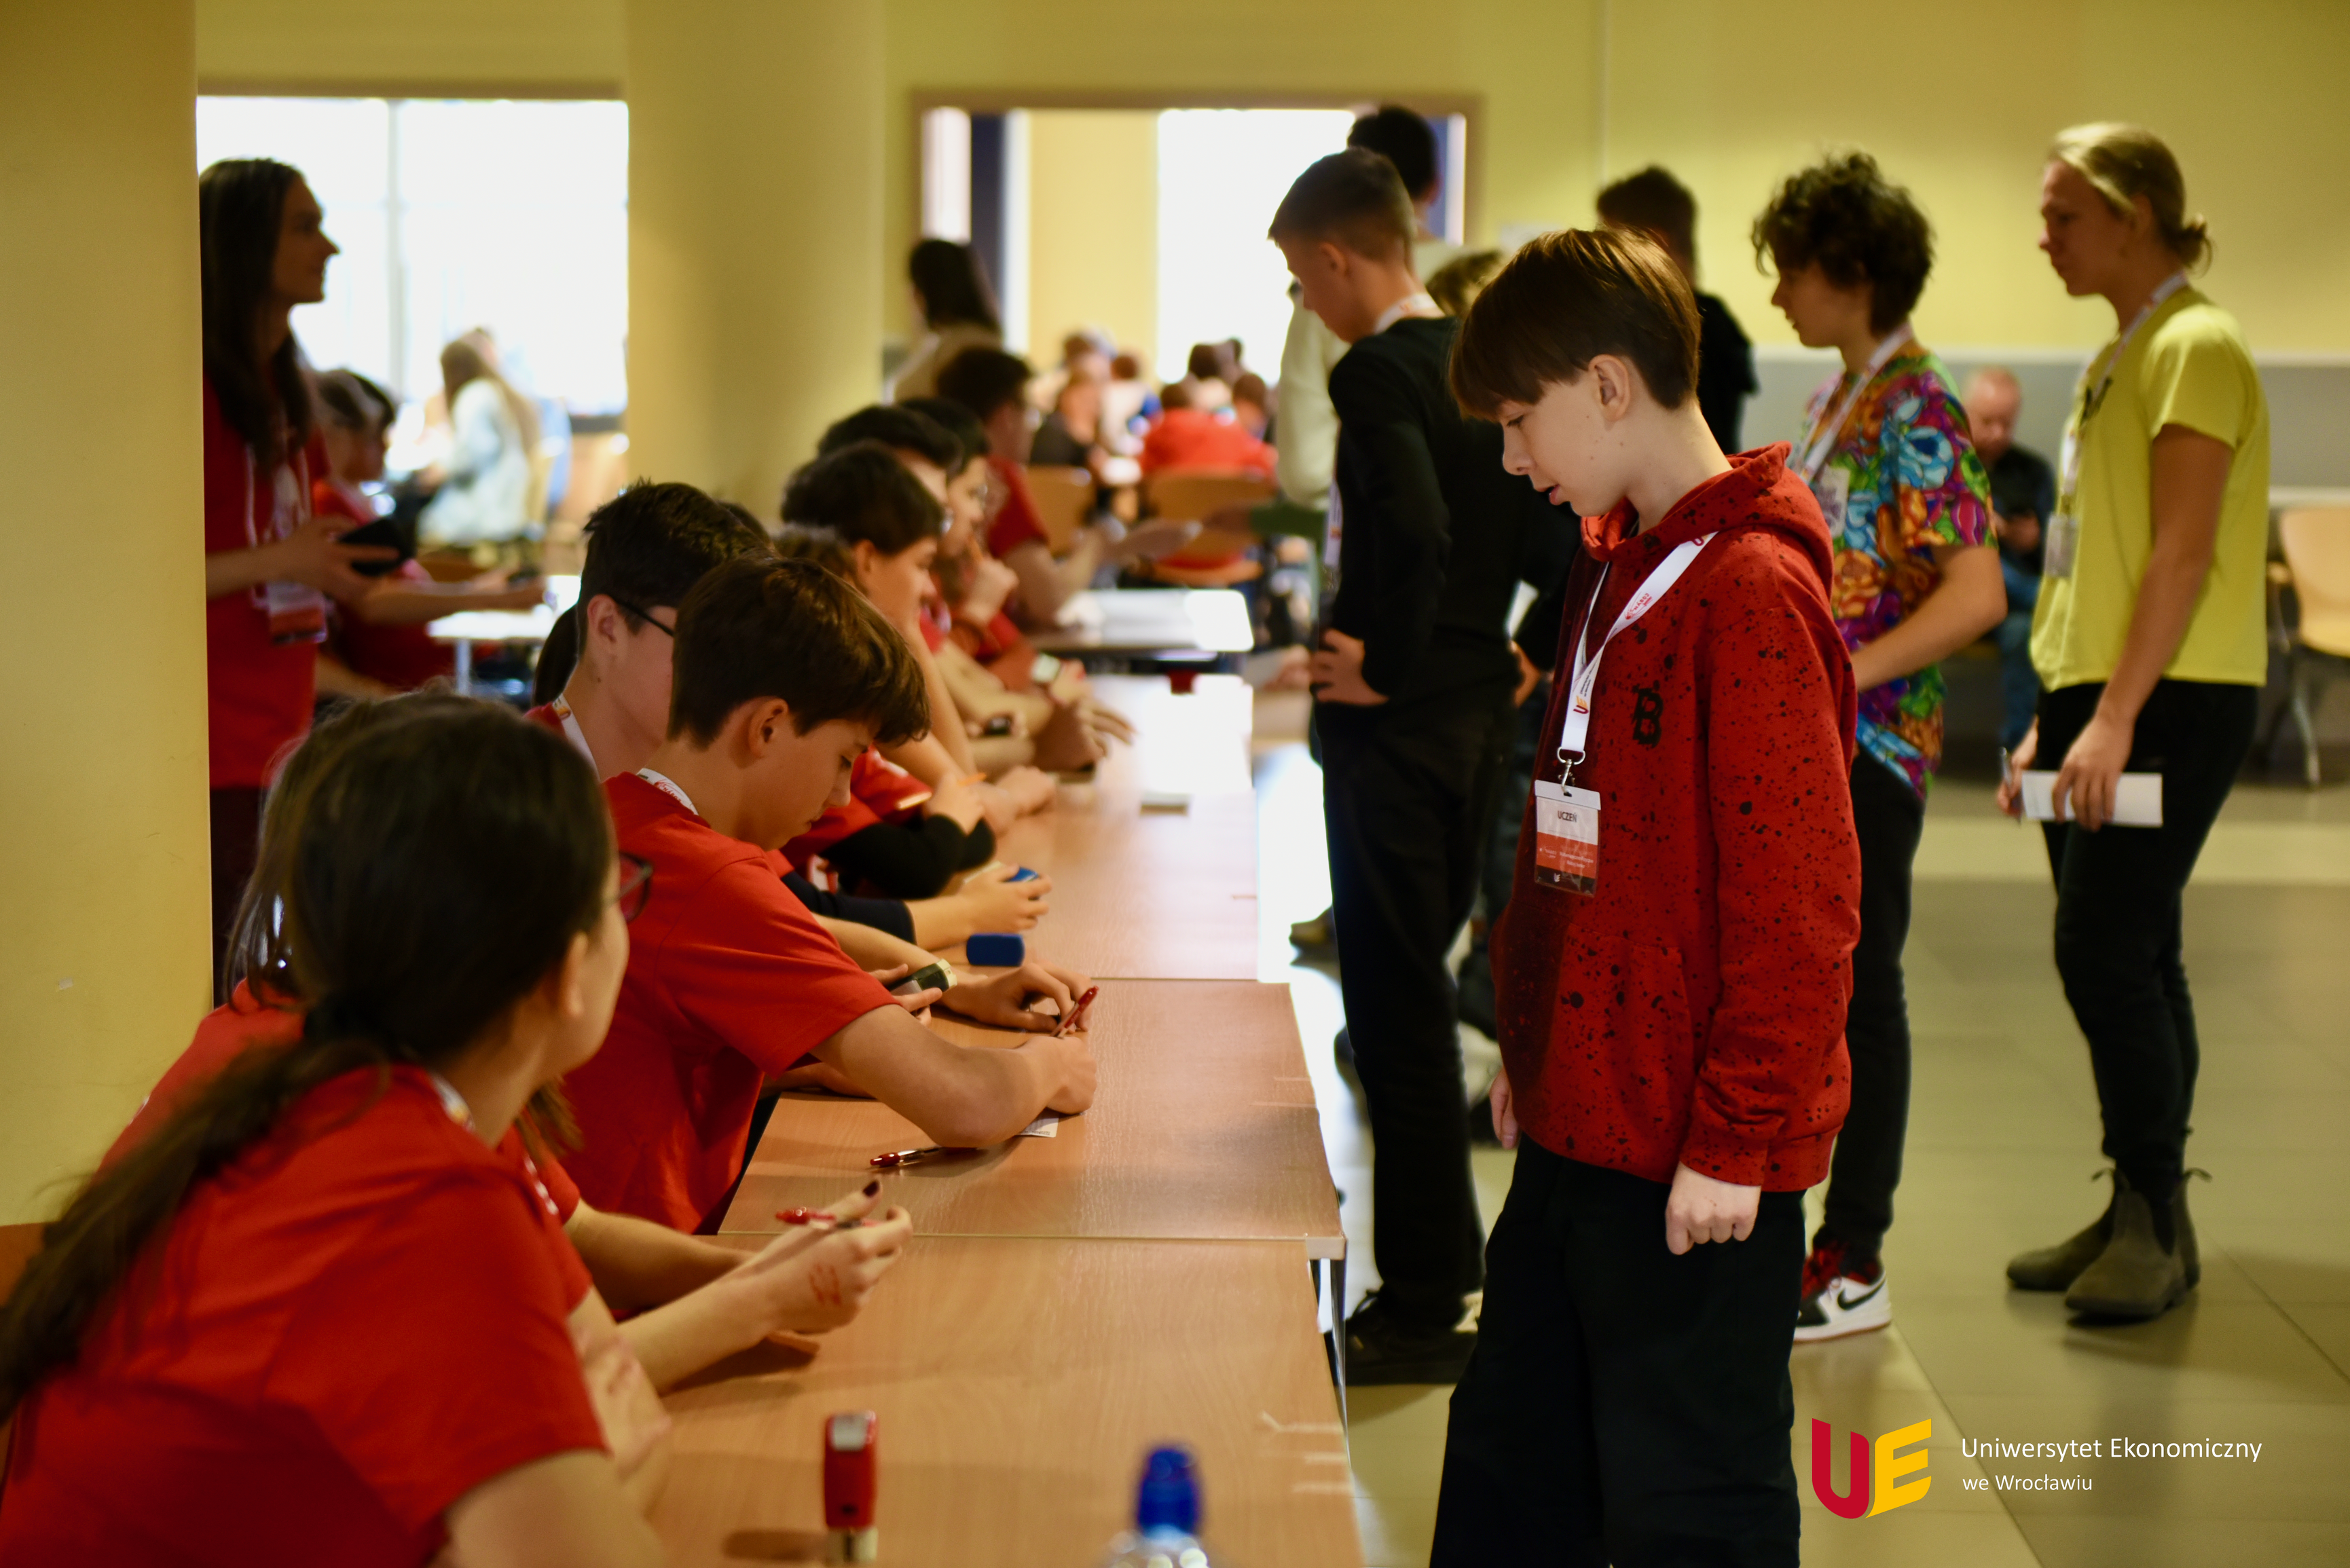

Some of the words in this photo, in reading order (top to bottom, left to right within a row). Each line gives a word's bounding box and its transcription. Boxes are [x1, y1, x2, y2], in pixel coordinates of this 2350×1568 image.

[1573, 695, 1589, 714] UE
[1632, 688, 1664, 748] B
[1558, 810, 1577, 823] UCZEŃ
